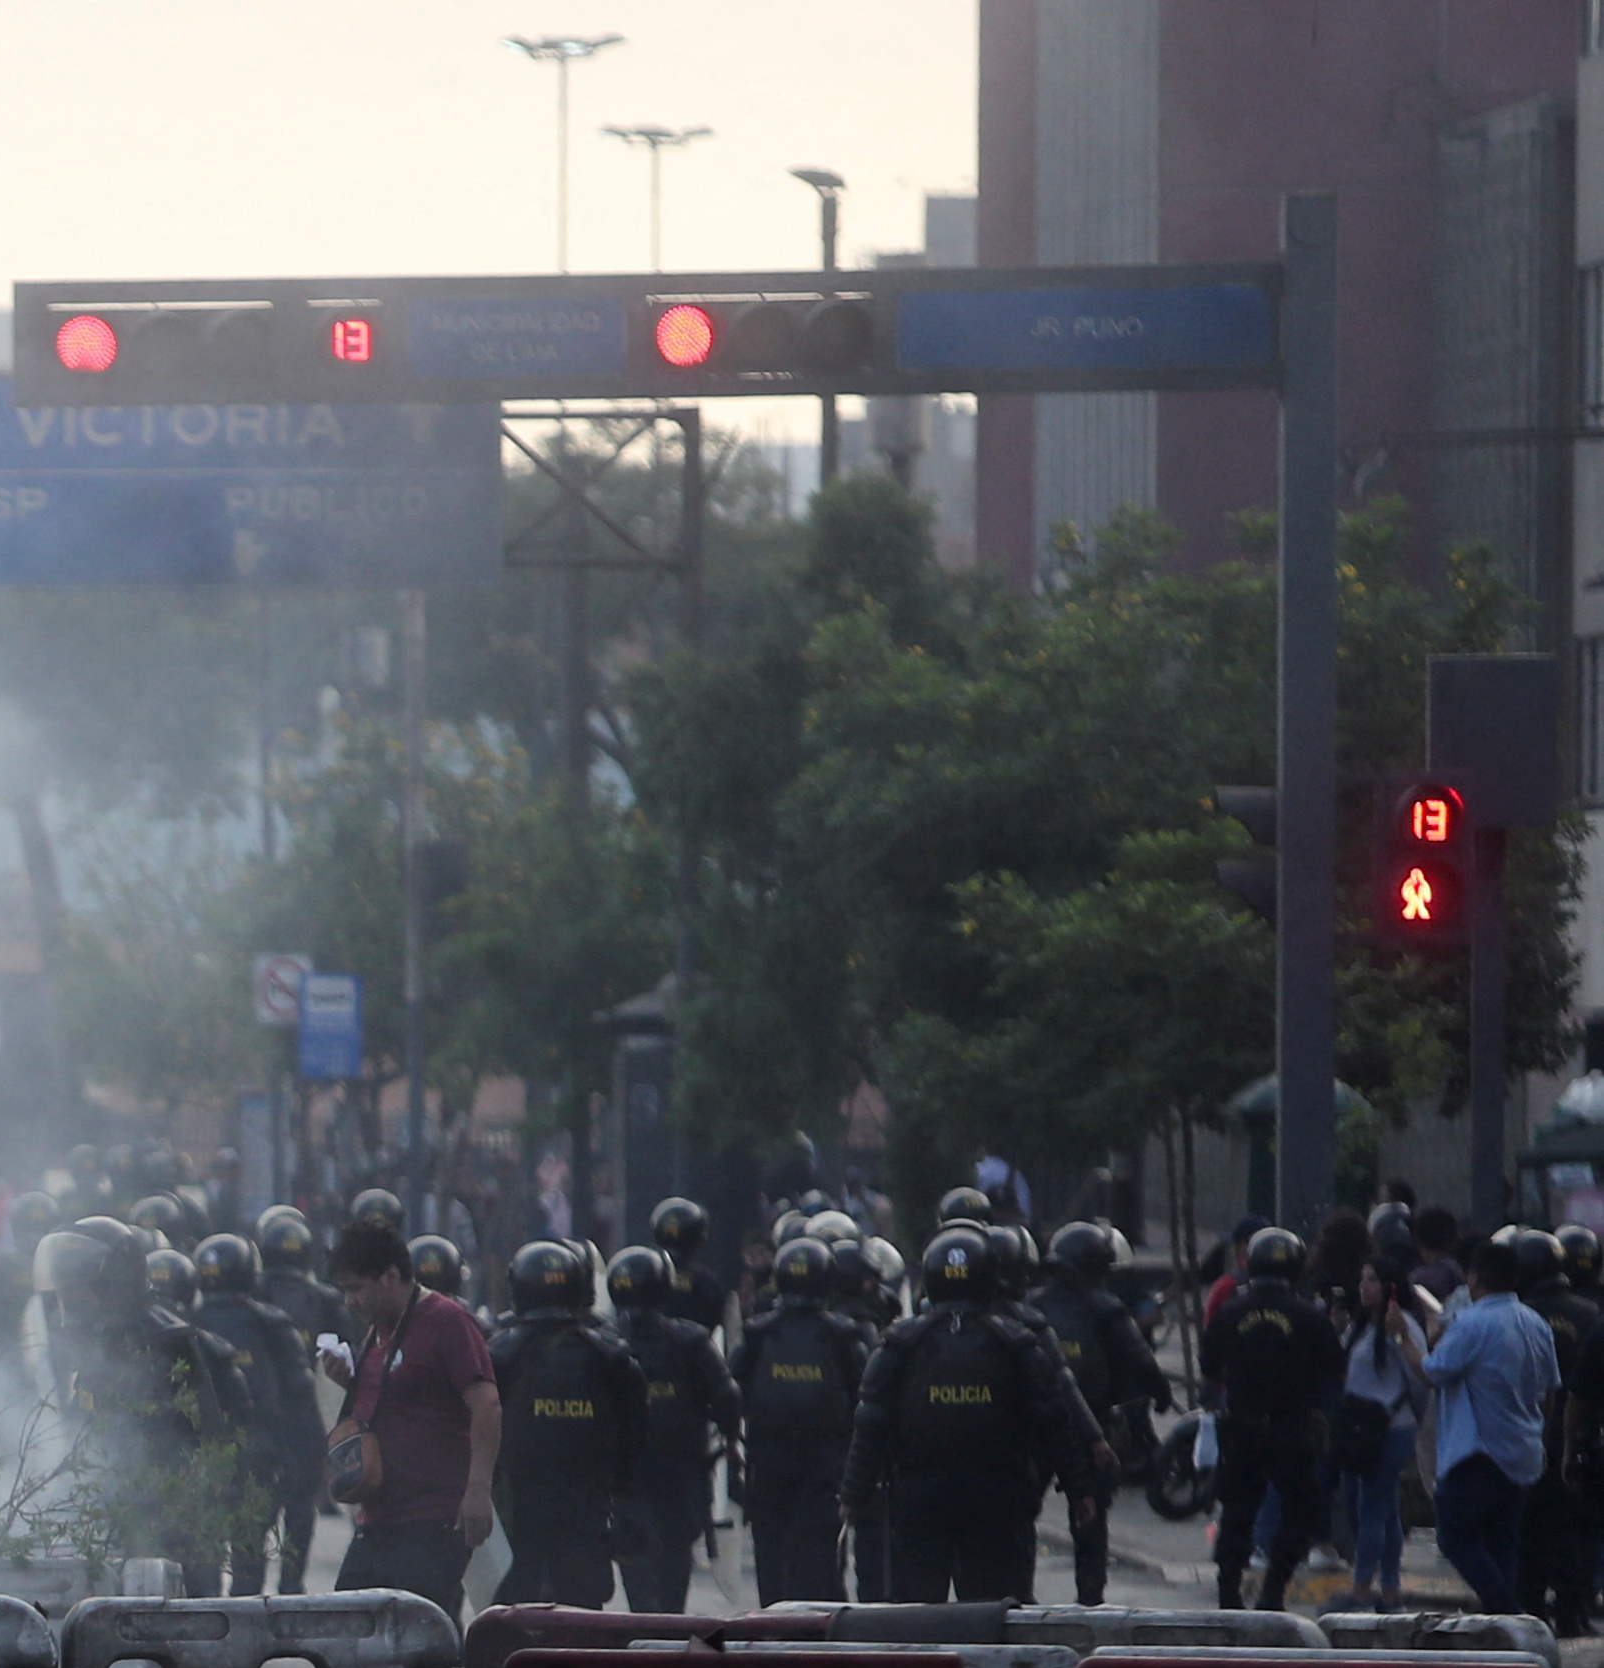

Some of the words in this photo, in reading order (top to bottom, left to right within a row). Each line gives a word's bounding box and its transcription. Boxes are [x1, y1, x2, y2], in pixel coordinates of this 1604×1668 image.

[333, 319, 371, 361] 13
[1073, 316, 1143, 338] PUNO
[15, 403, 347, 449] VICTORIA
[1412, 799, 1449, 842] 13
[534, 1398, 594, 1419] POLICIA
[930, 1385, 992, 1404] POLICIA
